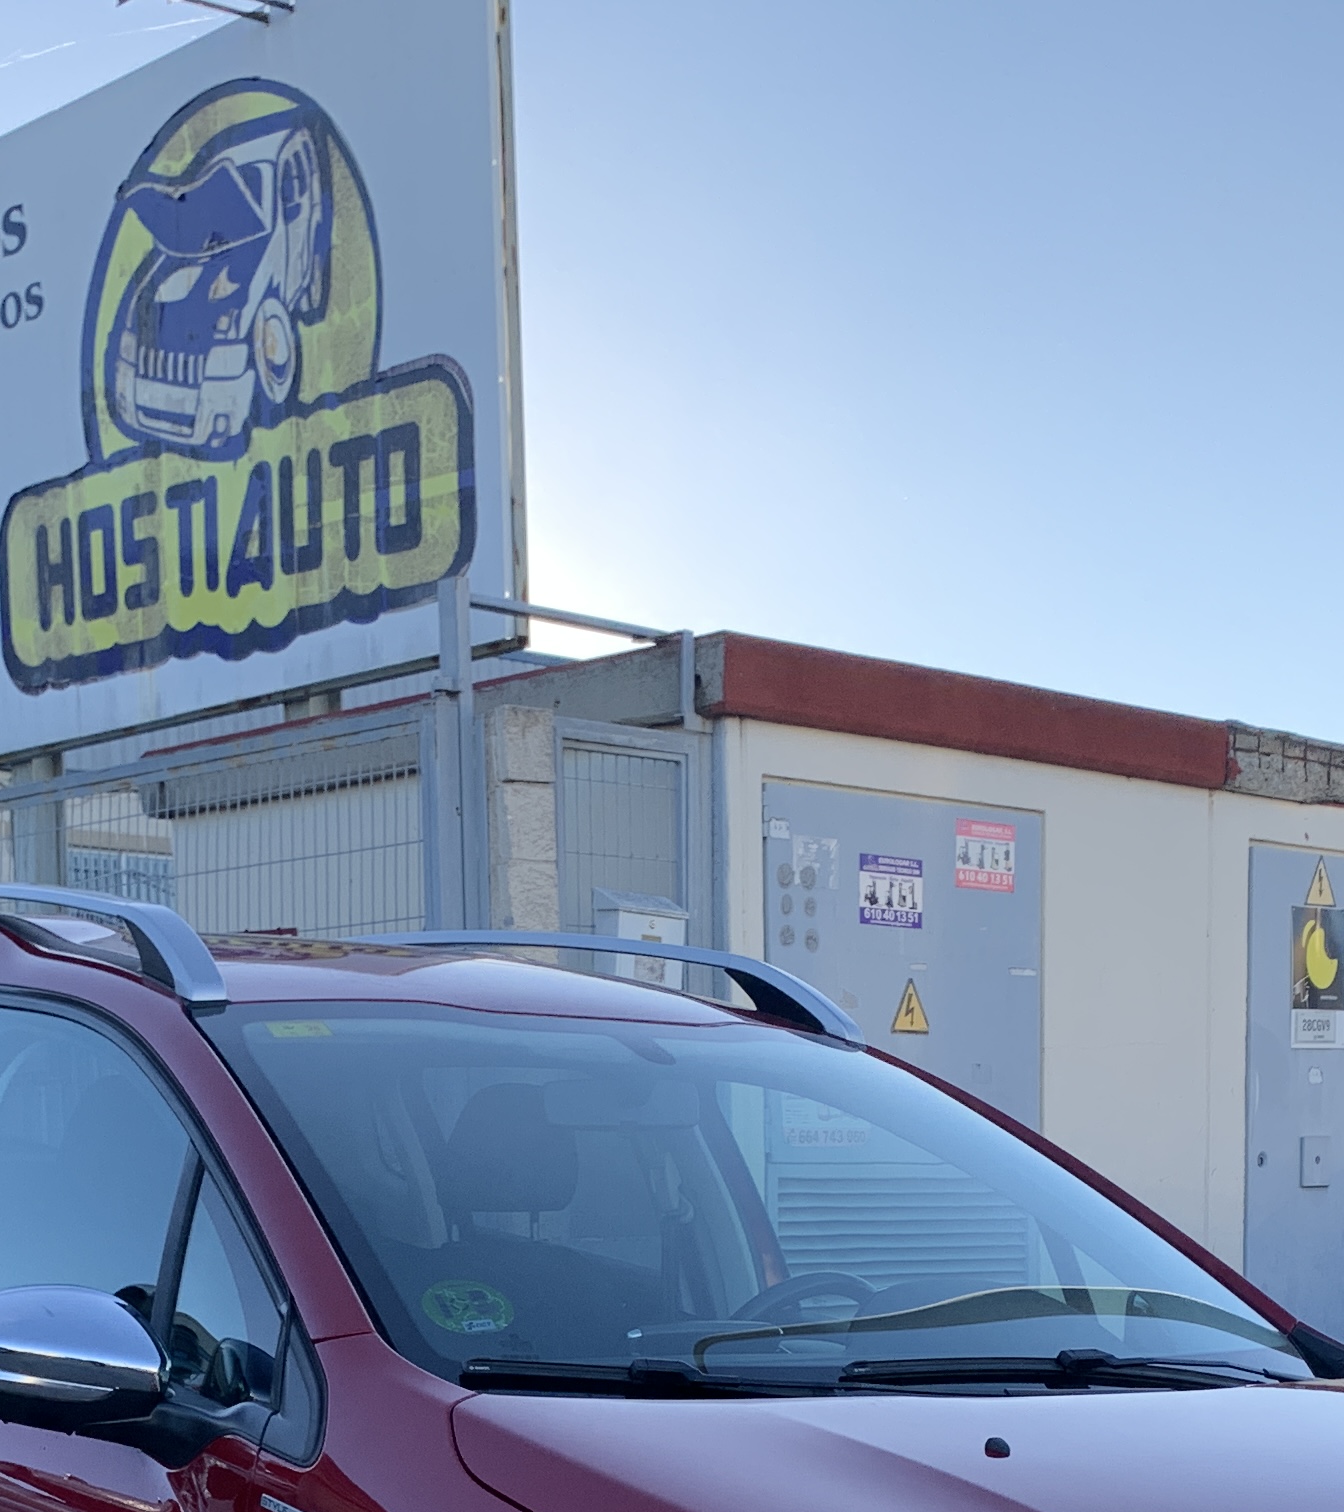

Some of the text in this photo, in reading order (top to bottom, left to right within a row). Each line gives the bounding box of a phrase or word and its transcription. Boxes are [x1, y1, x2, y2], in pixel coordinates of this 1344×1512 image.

[36, 421, 423, 632] HOSTIAUTO
[958, 870, 976, 881] 610
[990, 873, 1001, 885] 13
[1002, 874, 1013, 885] 51
[864, 907, 882, 920] 610
[882, 909, 895, 921] 40
[896, 911, 907, 922] 13
[908, 912, 919, 924] 51
